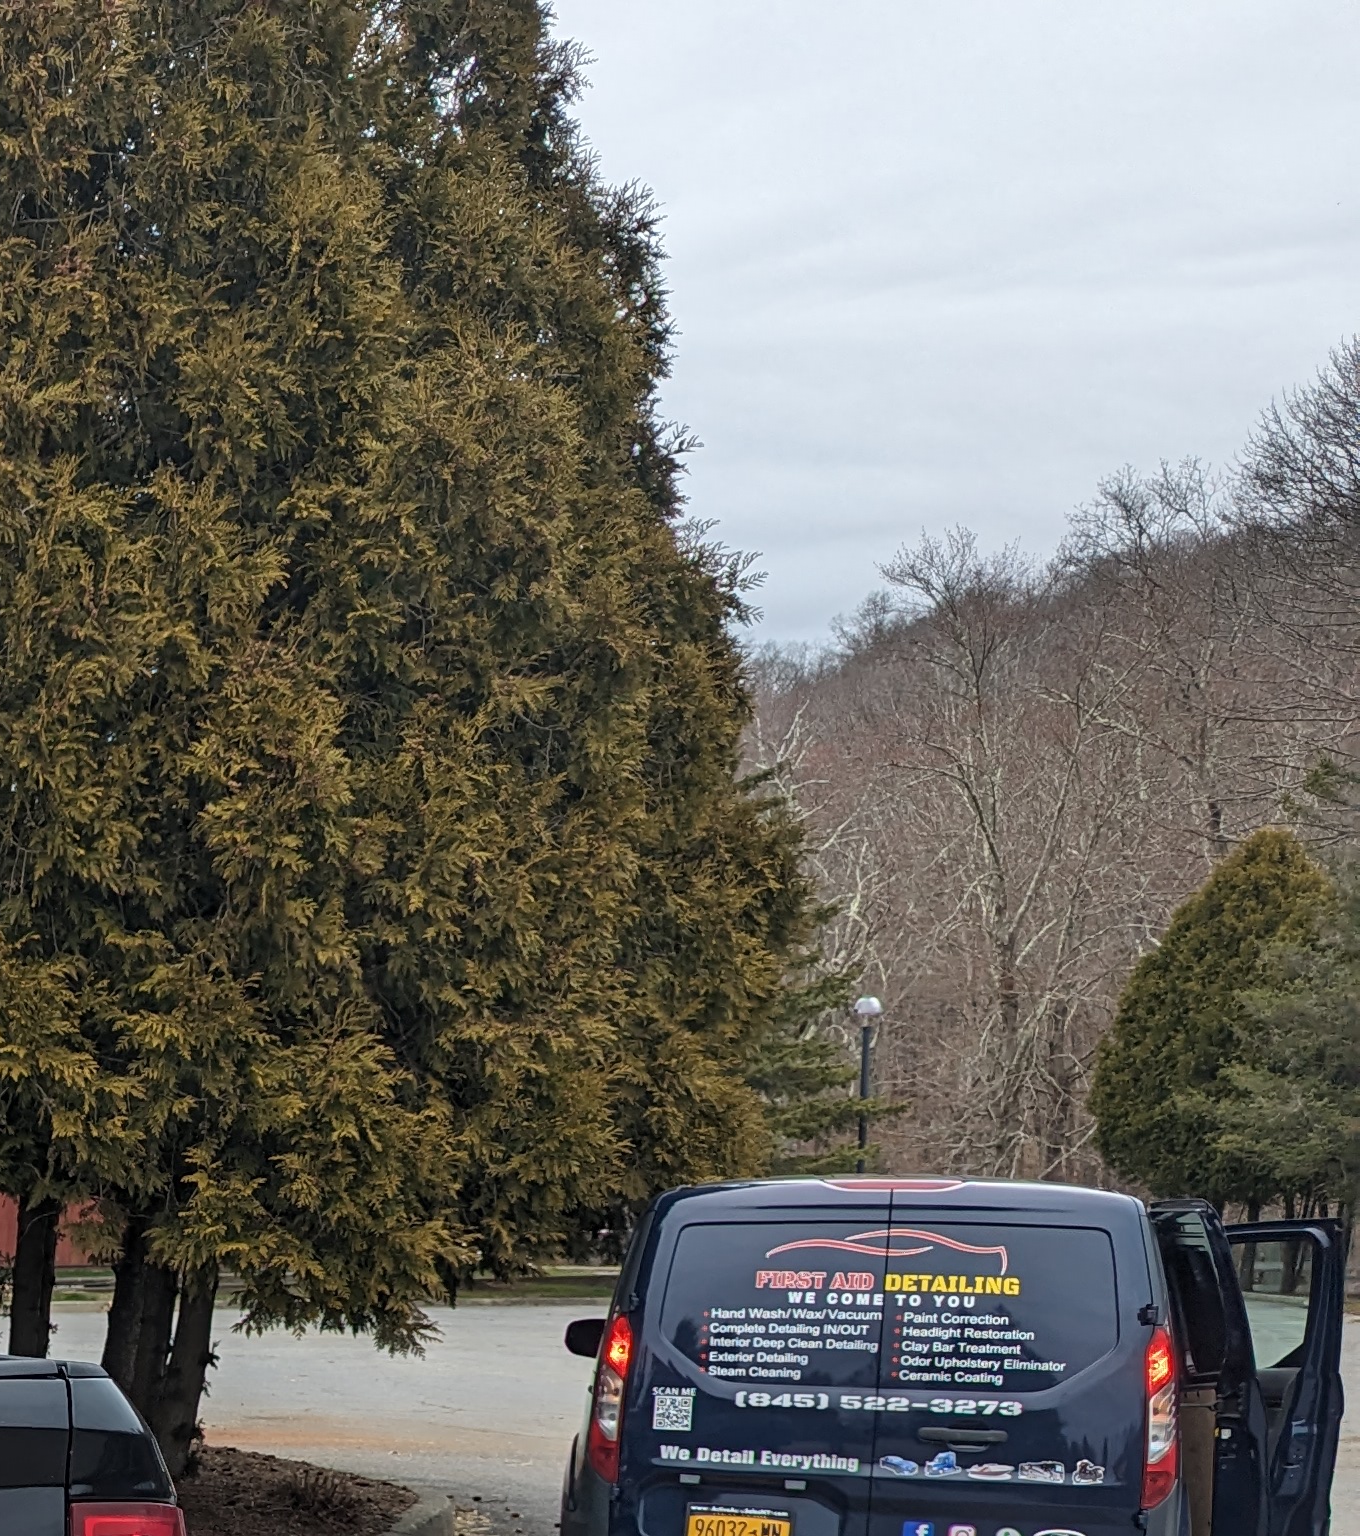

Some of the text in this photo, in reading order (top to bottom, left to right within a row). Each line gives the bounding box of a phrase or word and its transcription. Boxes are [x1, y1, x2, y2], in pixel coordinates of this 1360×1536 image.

[755, 1270, 1020, 1295] FIRST AID DETAILING
[787, 1292, 975, 1308] WE COME TO YOU
[710, 1308, 746, 1319] Hand
[903, 1312, 1009, 1325] Paint Correction
[709, 1322, 870, 1336] Complete Detailing IN/OUT
[902, 1327, 1034, 1341] Headlight Restoration
[709, 1336, 879, 1353] Interior Deep Clean Detailing
[901, 1340, 1021, 1355] Clay Bar Treatment
[709, 1351, 809, 1366] Exterior Detailing
[900, 1355, 1067, 1372] Odor Upholstery Eliminator
[708, 1365, 801, 1380] Steam Cleaning
[898, 1369, 1004, 1386] Ceramic Coating
[651, 1386, 697, 1397] SCAN ME
[734, 1390, 1023, 1416] (845) 522-3273
[659, 1444, 859, 1473] We Detail Everything
